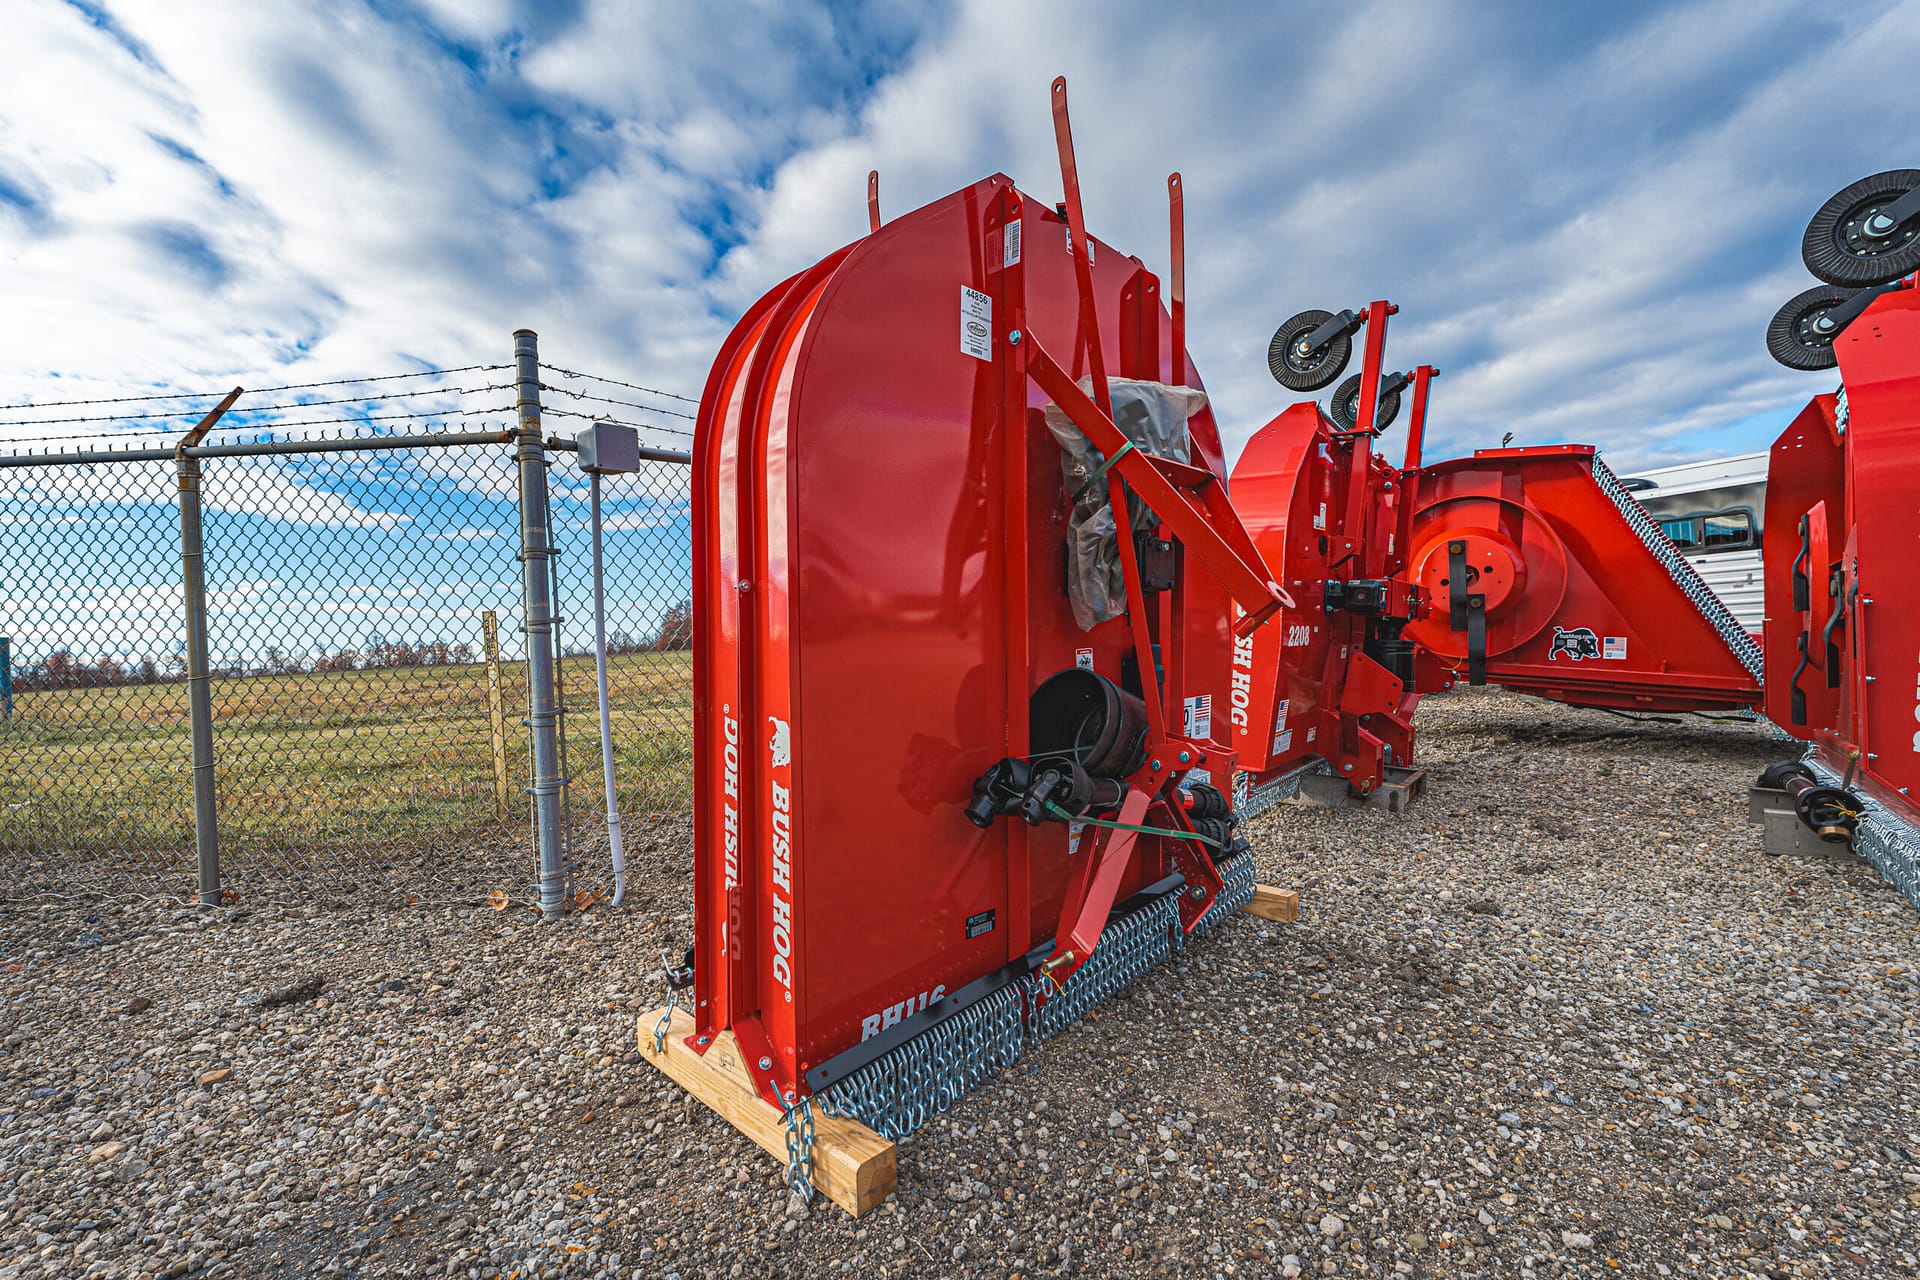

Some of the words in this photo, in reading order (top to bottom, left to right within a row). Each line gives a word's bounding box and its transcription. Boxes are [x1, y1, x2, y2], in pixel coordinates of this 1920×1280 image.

[966, 289, 988, 304] 44856
[1288, 625, 1310, 646] 2208
[772, 779, 790, 894] BUSH
